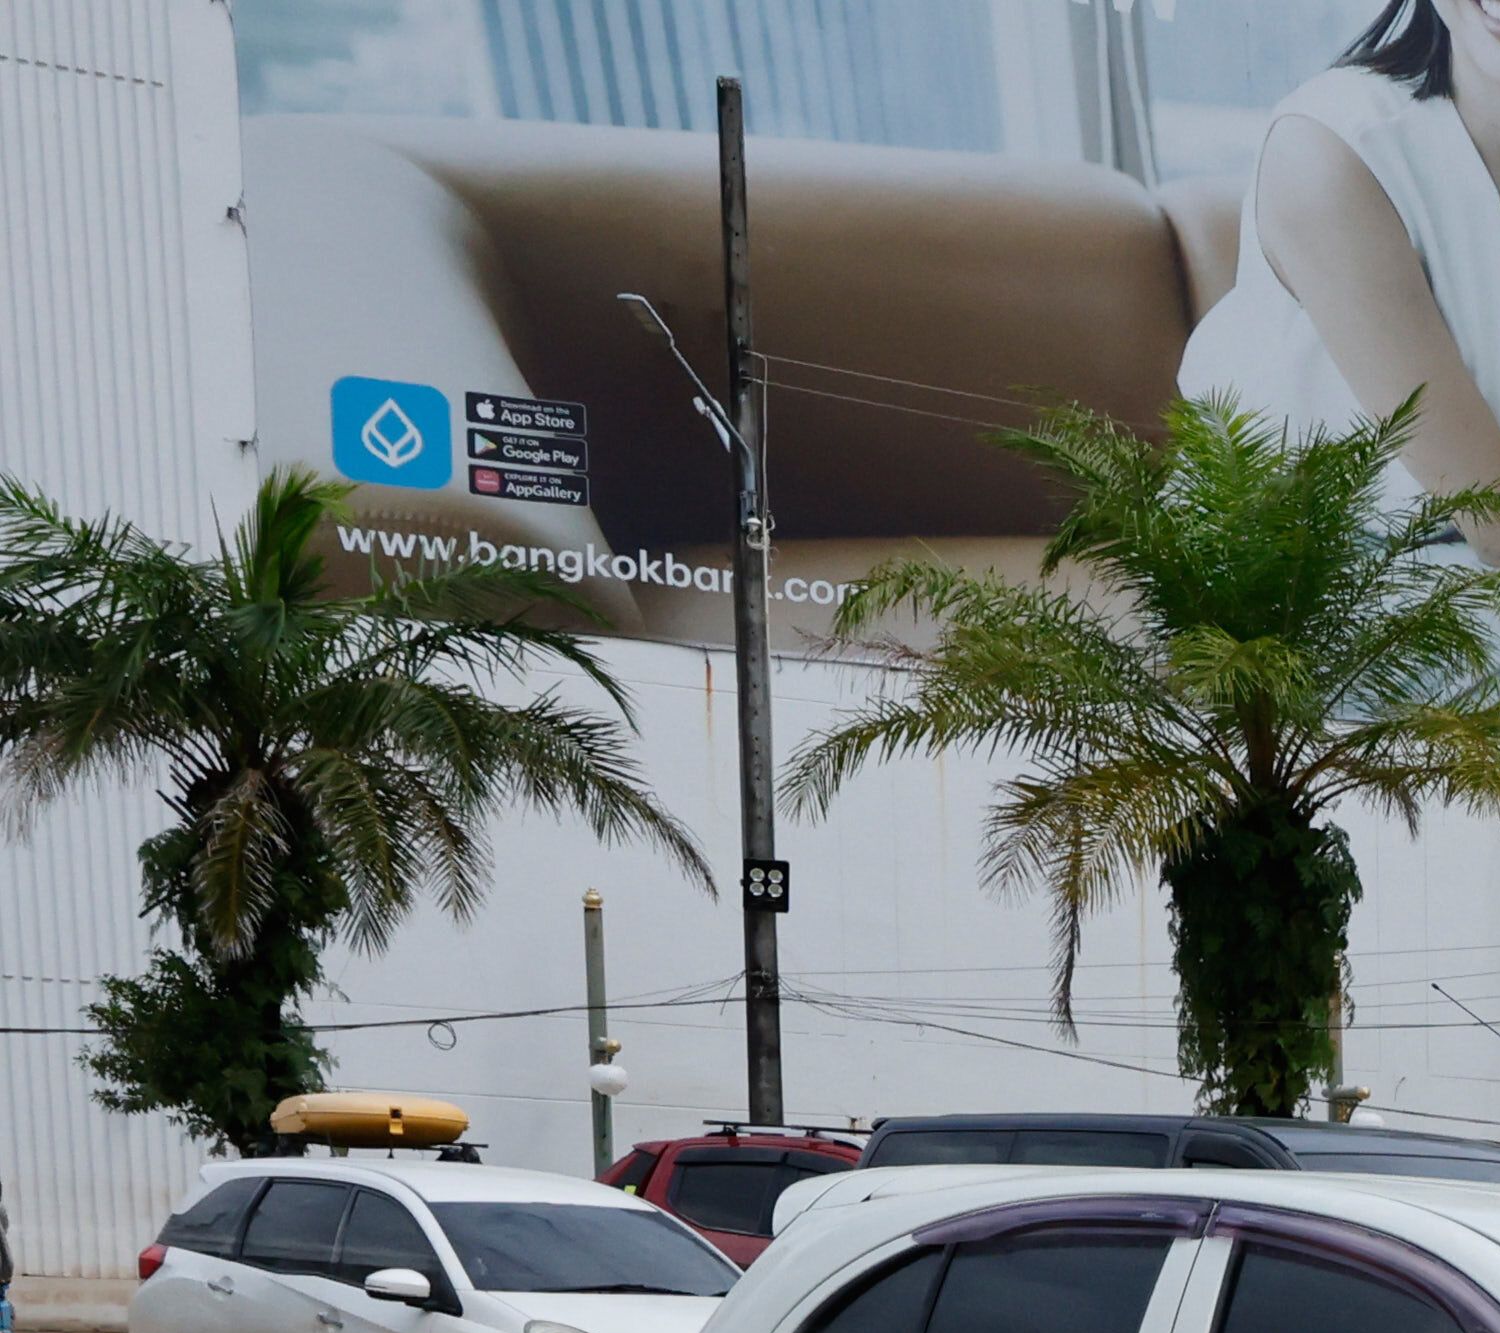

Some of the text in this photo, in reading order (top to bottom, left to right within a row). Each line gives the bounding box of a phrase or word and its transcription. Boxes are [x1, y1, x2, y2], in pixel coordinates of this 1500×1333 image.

[500, 409, 576, 429] App Store
[502, 435, 517, 445] GET
[502, 444, 580, 467] Google Play
[505, 482, 582, 503] AppGallery
